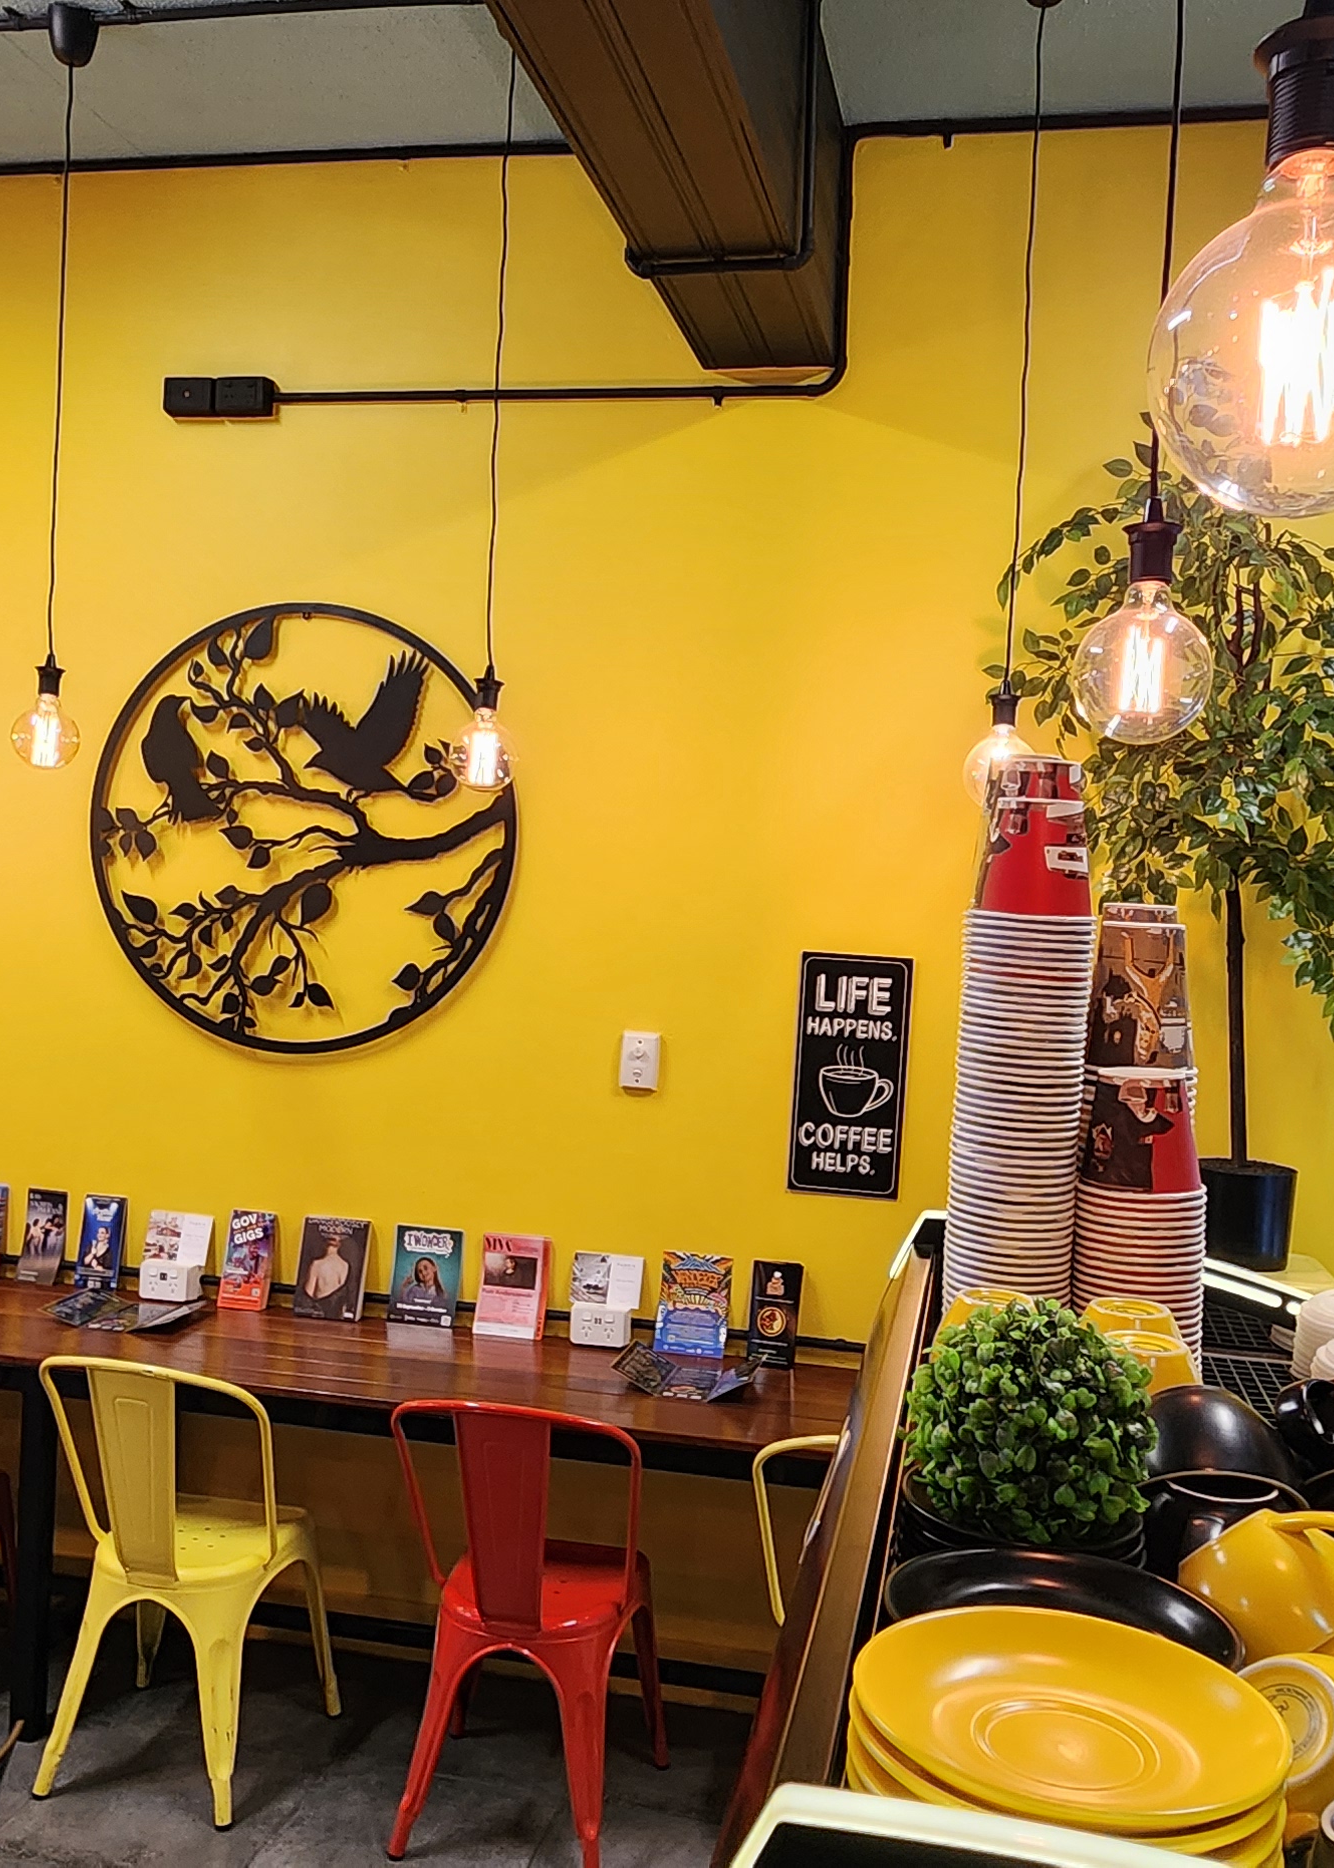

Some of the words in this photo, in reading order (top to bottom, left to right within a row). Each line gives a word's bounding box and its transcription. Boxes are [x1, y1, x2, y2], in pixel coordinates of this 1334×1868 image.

[815, 973, 893, 1016] LIFE
[806, 1016, 898, 1042] HAPPENS.
[798, 1122, 893, 1154] COFFEE
[811, 1152, 876, 1175] HELPS.
[232, 1213, 258, 1230] GOV
[233, 1228, 264, 1245] GIGS
